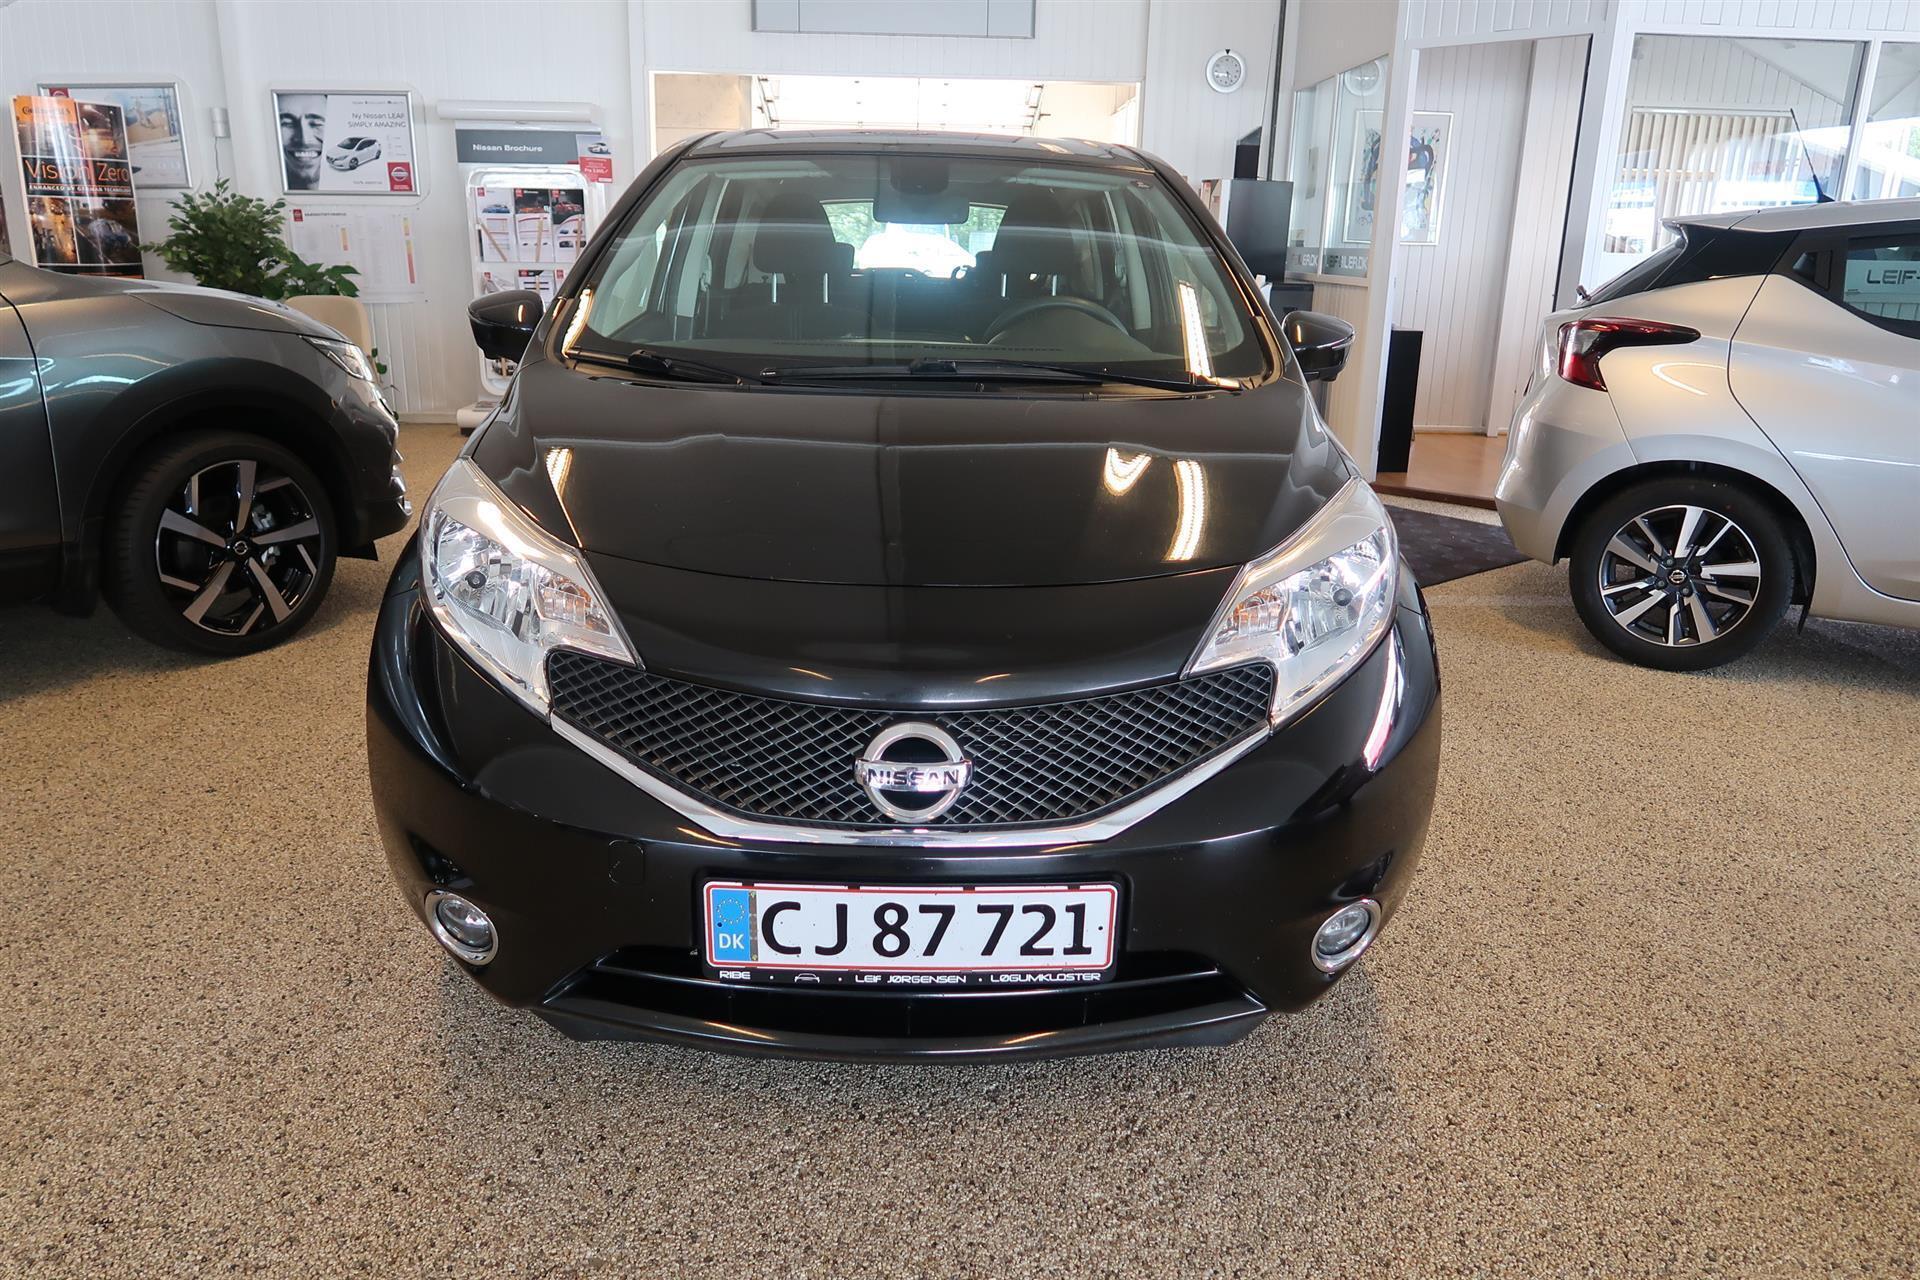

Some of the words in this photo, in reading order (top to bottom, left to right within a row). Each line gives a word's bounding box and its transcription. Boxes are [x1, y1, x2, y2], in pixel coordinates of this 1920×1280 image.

[472, 143, 502, 152] Nissan
[504, 144, 543, 153] Brochure
[24, 159, 91, 180] Vision
[96, 162, 130, 182] Zero
[866, 767, 960, 787] NISSAN
[761, 901, 848, 956] CJ
[872, 902, 956, 958] 87
[976, 903, 1092, 957] 721
[718, 932, 745, 950] DK
[719, 970, 751, 980] RIBE
[855, 974, 882, 984] LEIF
[887, 974, 967, 984] JØRGENSEN
[990, 972, 1101, 983] LØGUMKLOSTER
